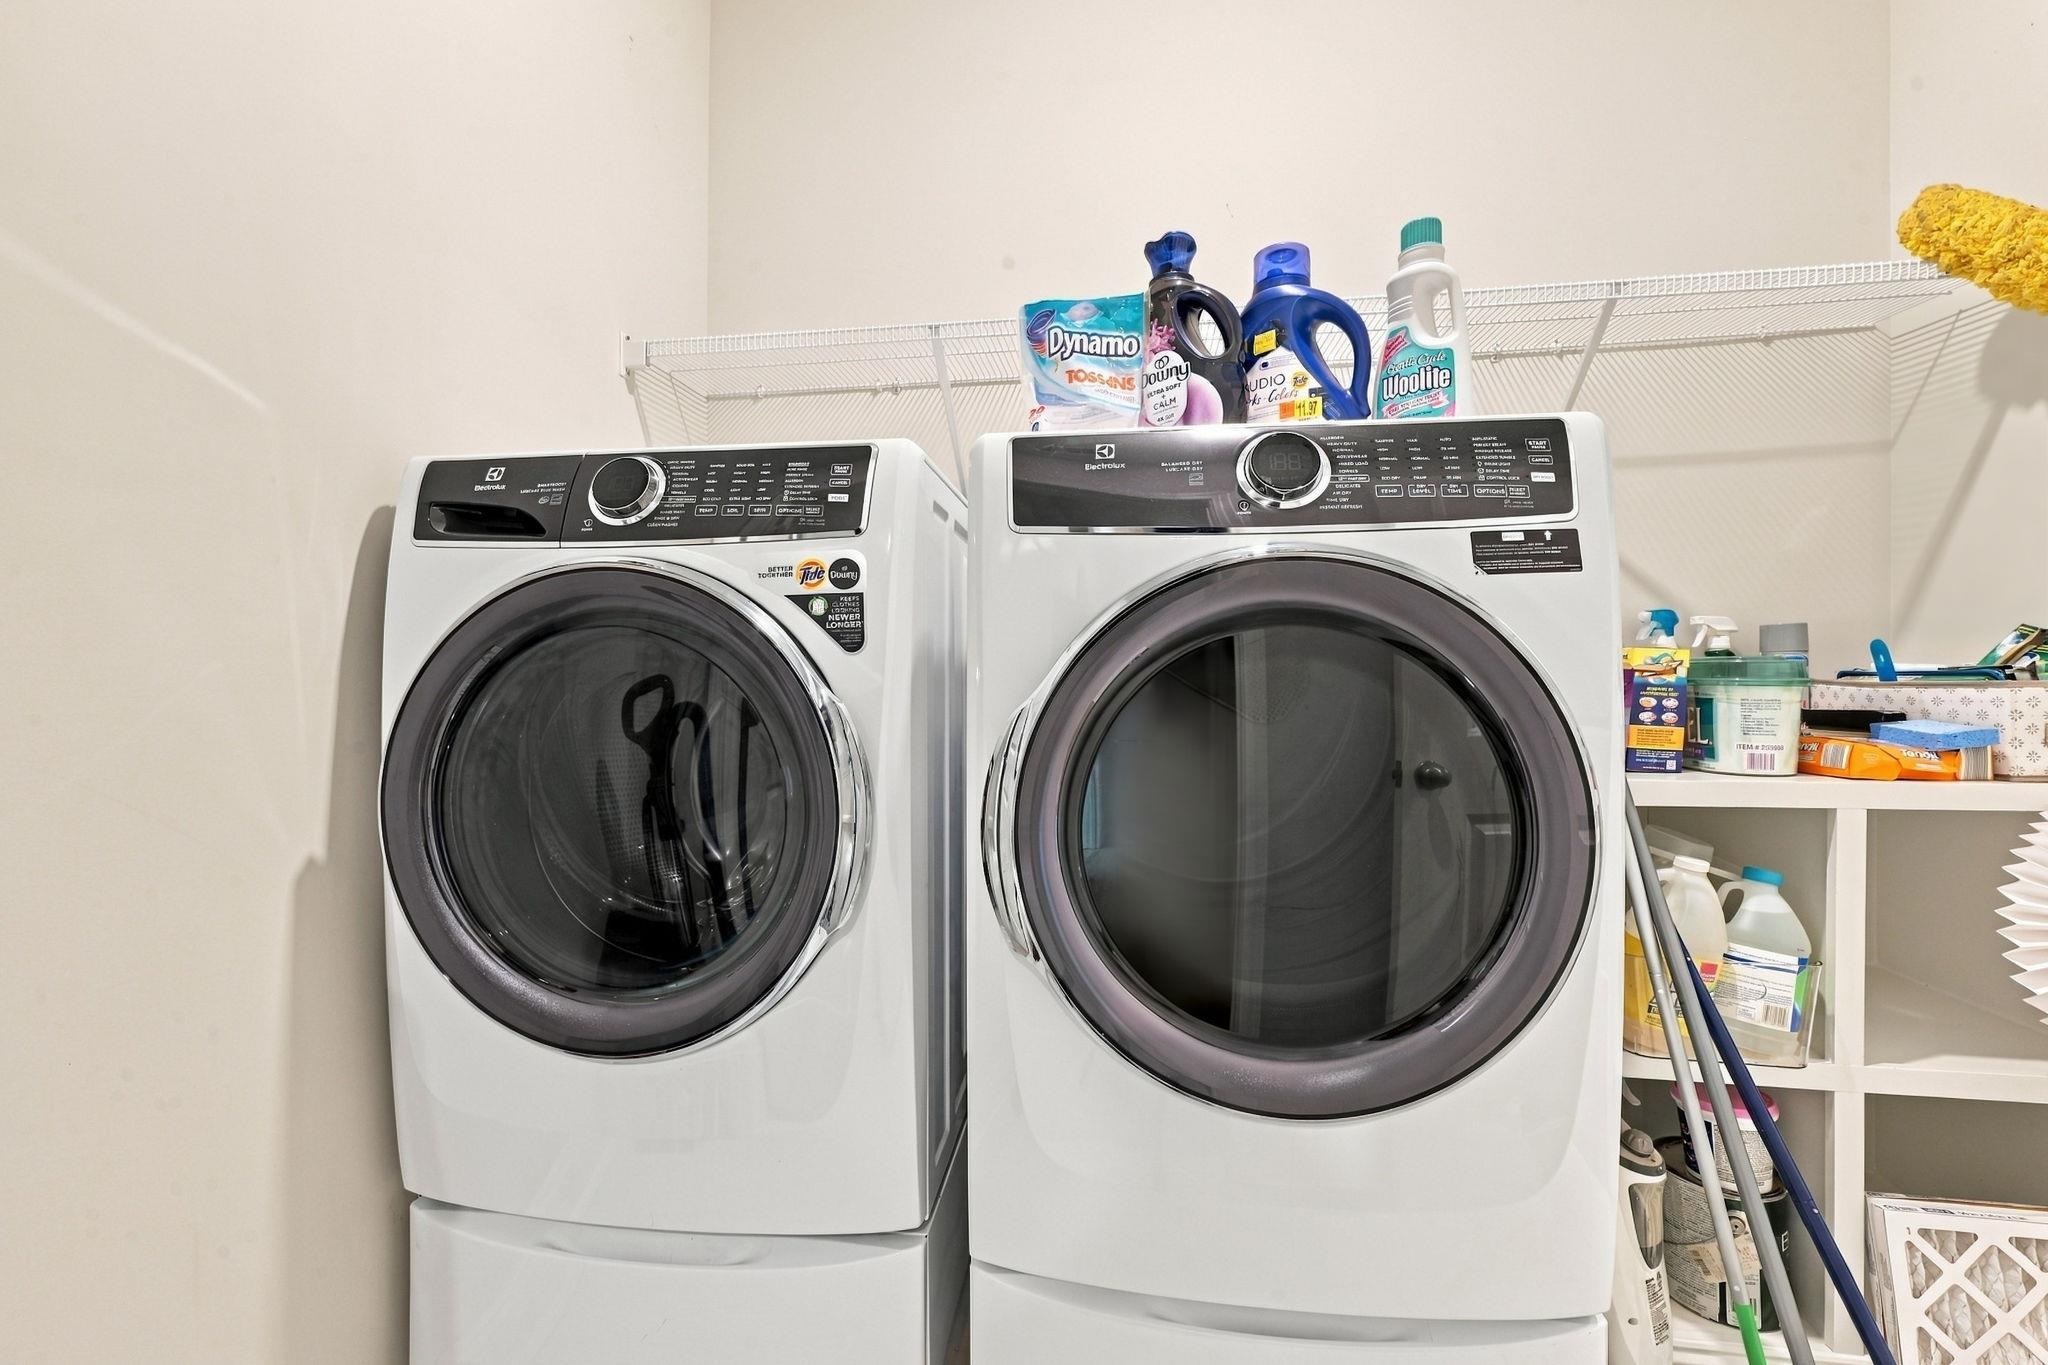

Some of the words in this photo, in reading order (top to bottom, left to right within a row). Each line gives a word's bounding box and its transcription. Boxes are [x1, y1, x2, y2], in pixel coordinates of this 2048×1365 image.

[1048, 326, 1140, 361] Dynamo
[1142, 362, 1190, 390] Downy
[1165, 382, 1182, 392] SOFT
[1382, 365, 1452, 402] Woolite
[1153, 397, 1177, 411] CALM
[1084, 462, 1127, 471] Electrolux
[474, 483, 507, 492] Electrolux
[758, 571, 793, 579] TOGETHER
[799, 566, 826, 585] Tide
[830, 570, 858, 581] Downy
[828, 613, 861, 621] NEWER
